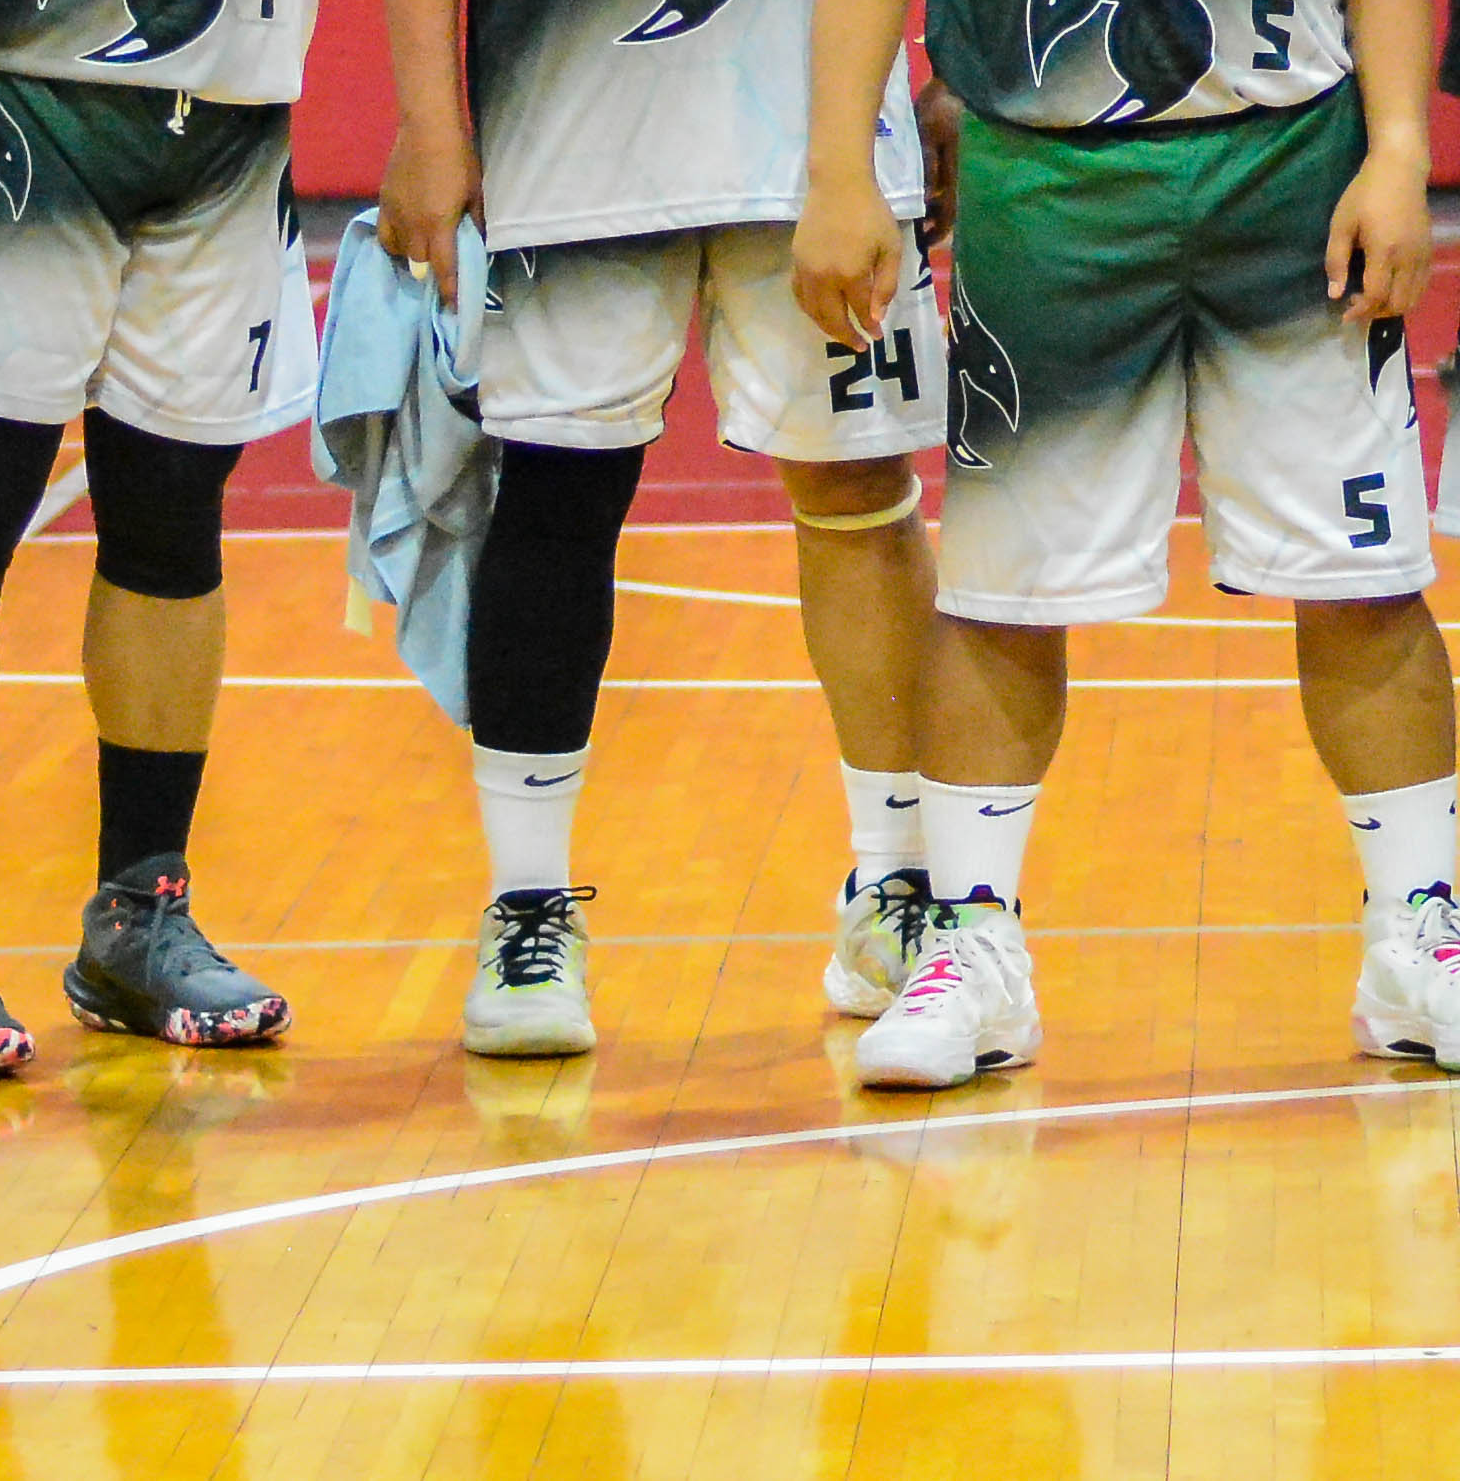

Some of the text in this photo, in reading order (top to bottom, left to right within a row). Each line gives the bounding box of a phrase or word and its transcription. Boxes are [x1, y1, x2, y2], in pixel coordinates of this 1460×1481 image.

[247, 318, 271, 393] 7
[827, 328, 919, 413] 24
[1344, 472, 1391, 547] 5
